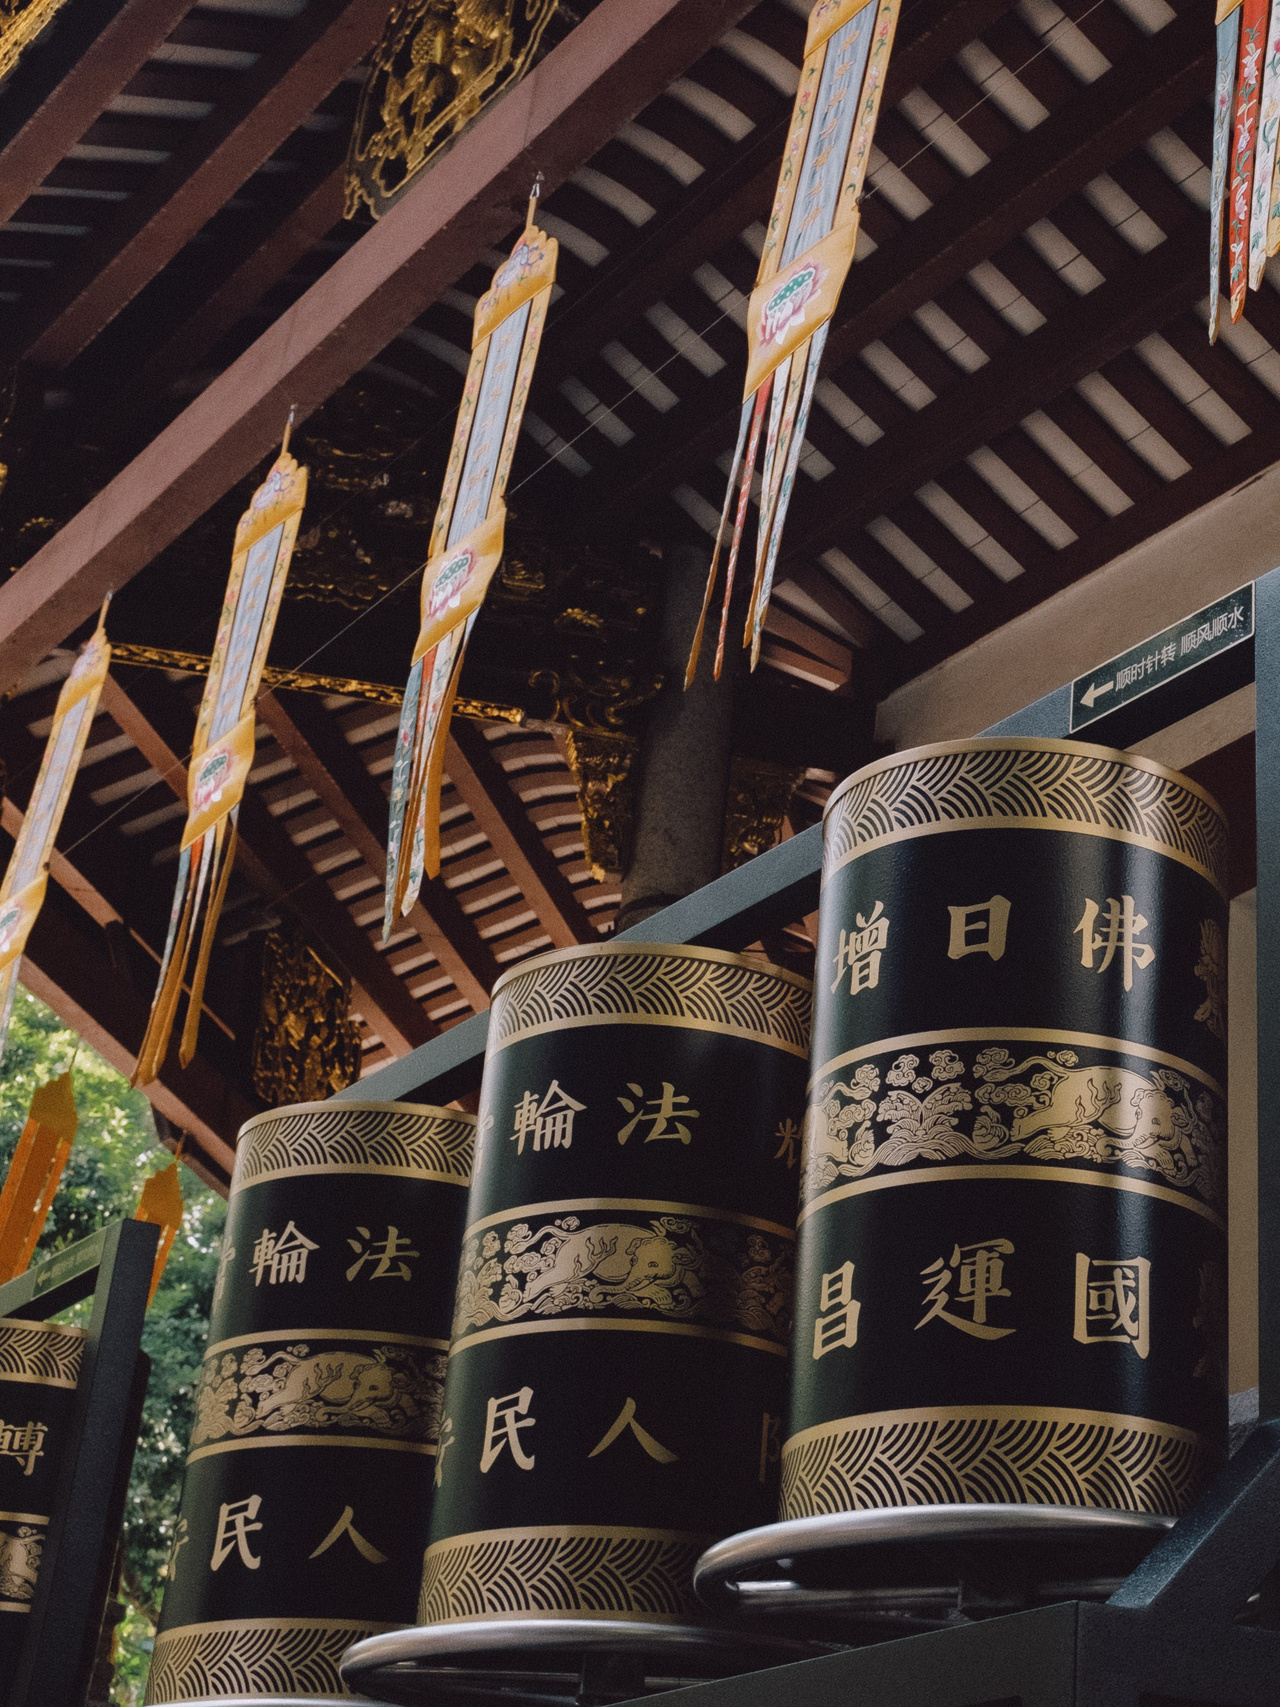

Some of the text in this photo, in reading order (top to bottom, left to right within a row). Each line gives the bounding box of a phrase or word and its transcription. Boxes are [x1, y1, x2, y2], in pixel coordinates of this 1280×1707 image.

[1115, 606, 1245, 692] 顺时针转 顺风顺水
